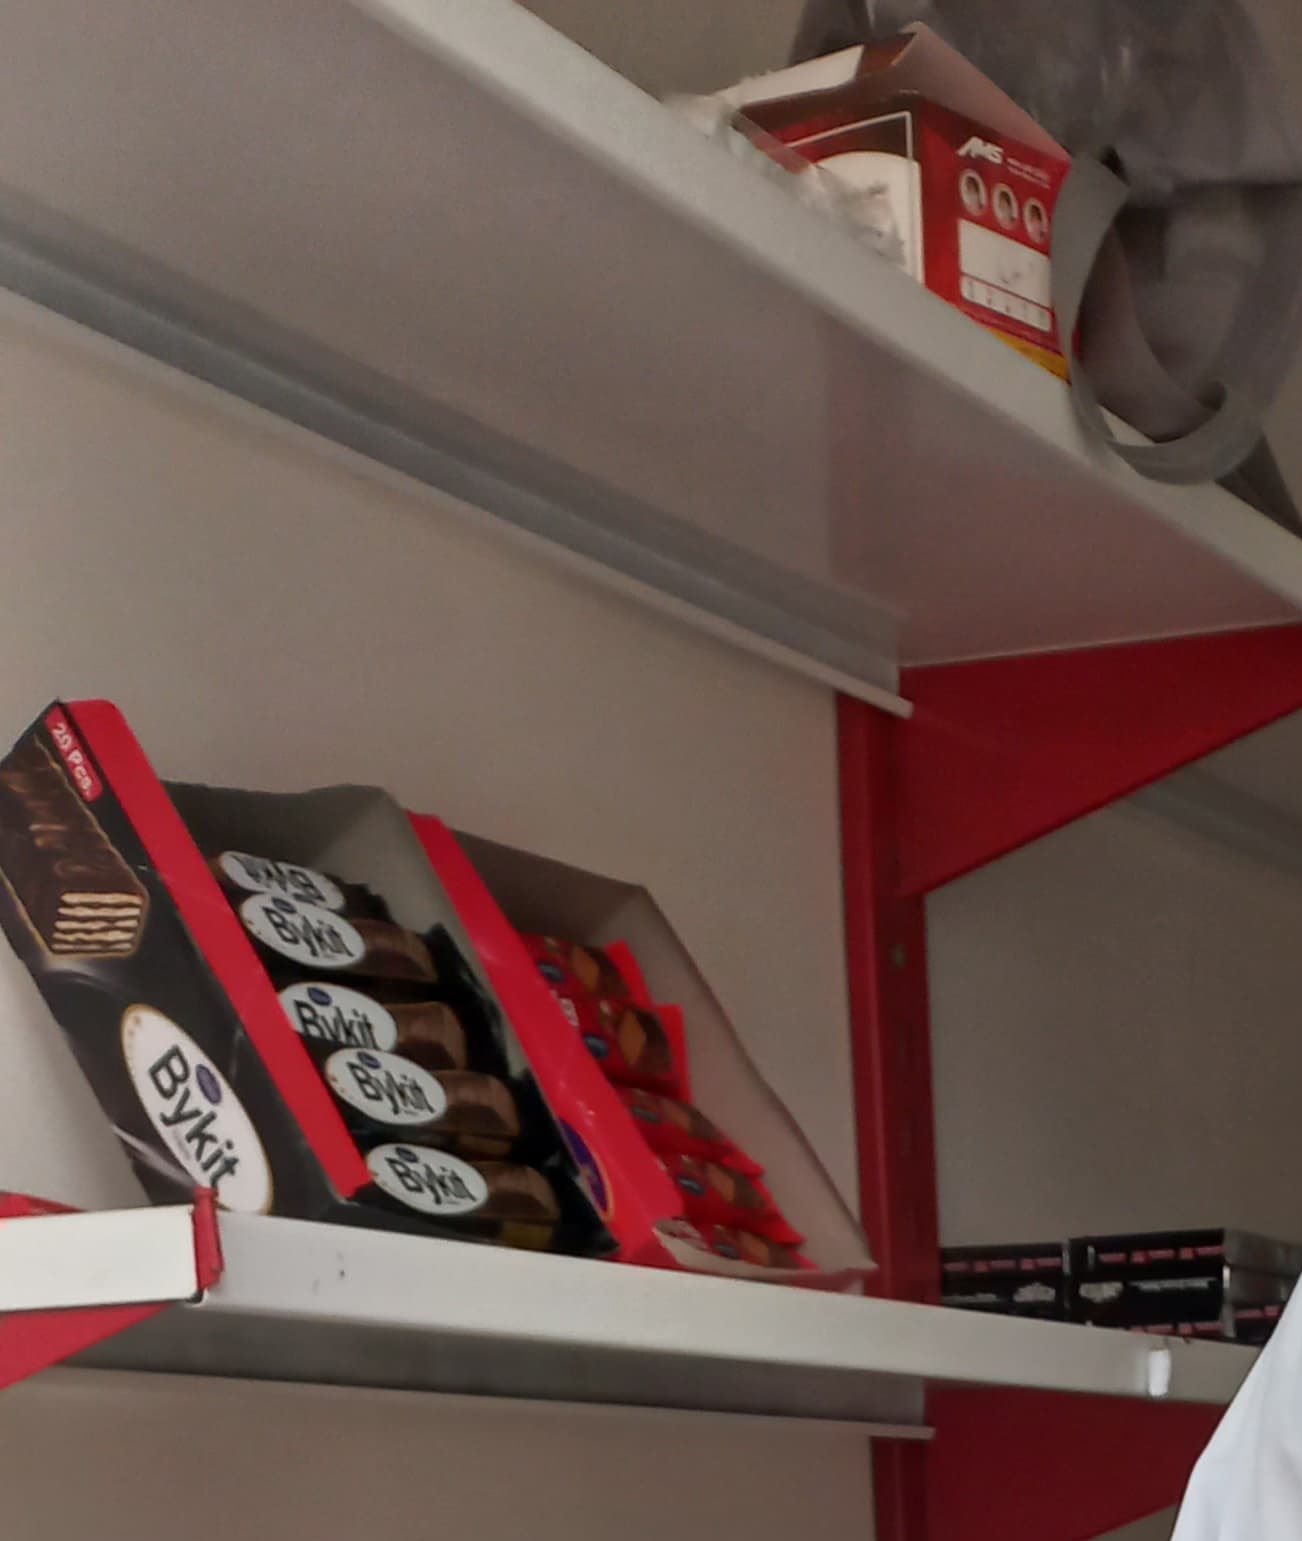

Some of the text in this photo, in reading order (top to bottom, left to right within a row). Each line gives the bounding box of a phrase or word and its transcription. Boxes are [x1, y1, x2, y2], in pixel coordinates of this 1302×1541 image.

[52, 721, 93, 798] 20 Pcs.
[262, 907, 354, 957] Bykit
[347, 1061, 435, 1115] Bykit
[149, 1045, 241, 1192] Bykit
[385, 1157, 477, 1204] Bykit
